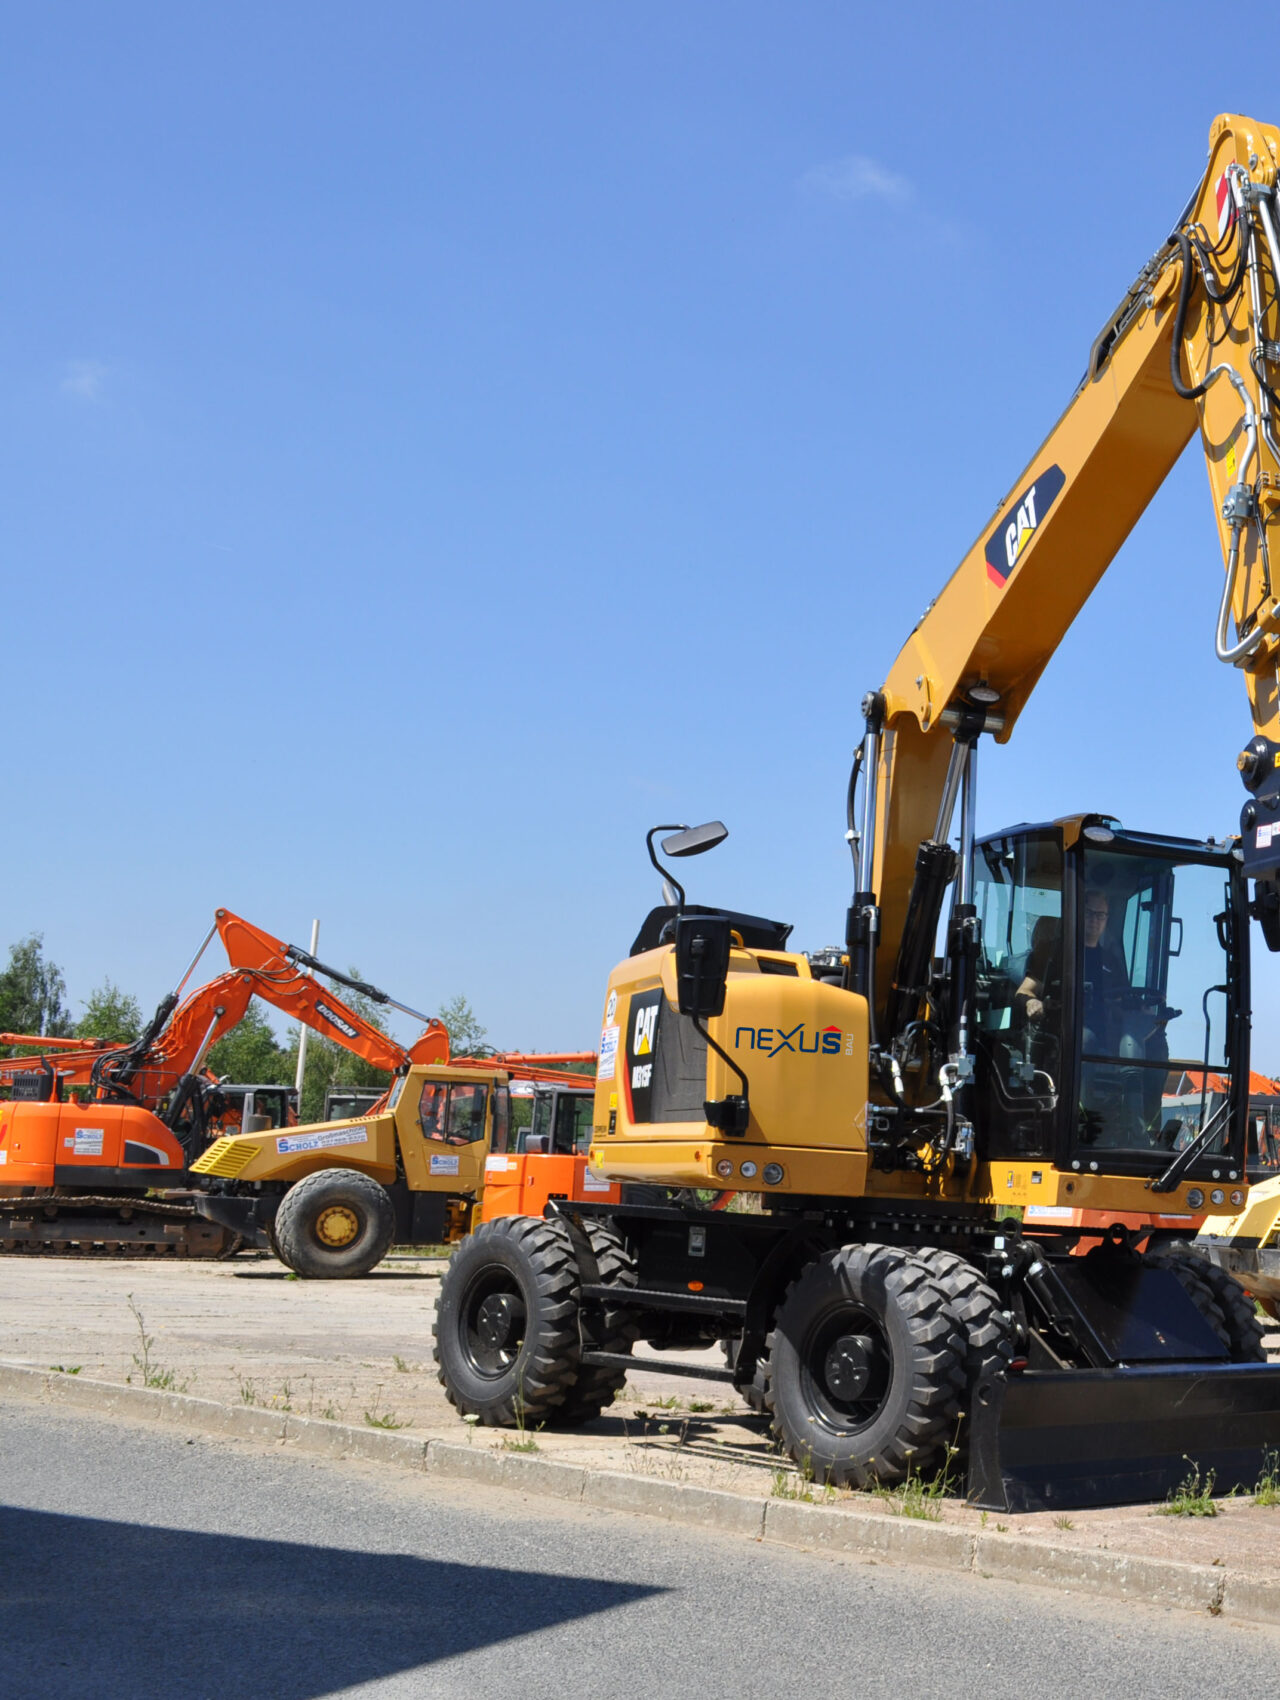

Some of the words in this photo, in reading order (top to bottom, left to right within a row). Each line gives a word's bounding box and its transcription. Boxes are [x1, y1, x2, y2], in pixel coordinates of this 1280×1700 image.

[1005, 485, 1037, 567] CAT
[316, 1004, 357, 1037] DOOSAN
[633, 1004, 658, 1056] CAT
